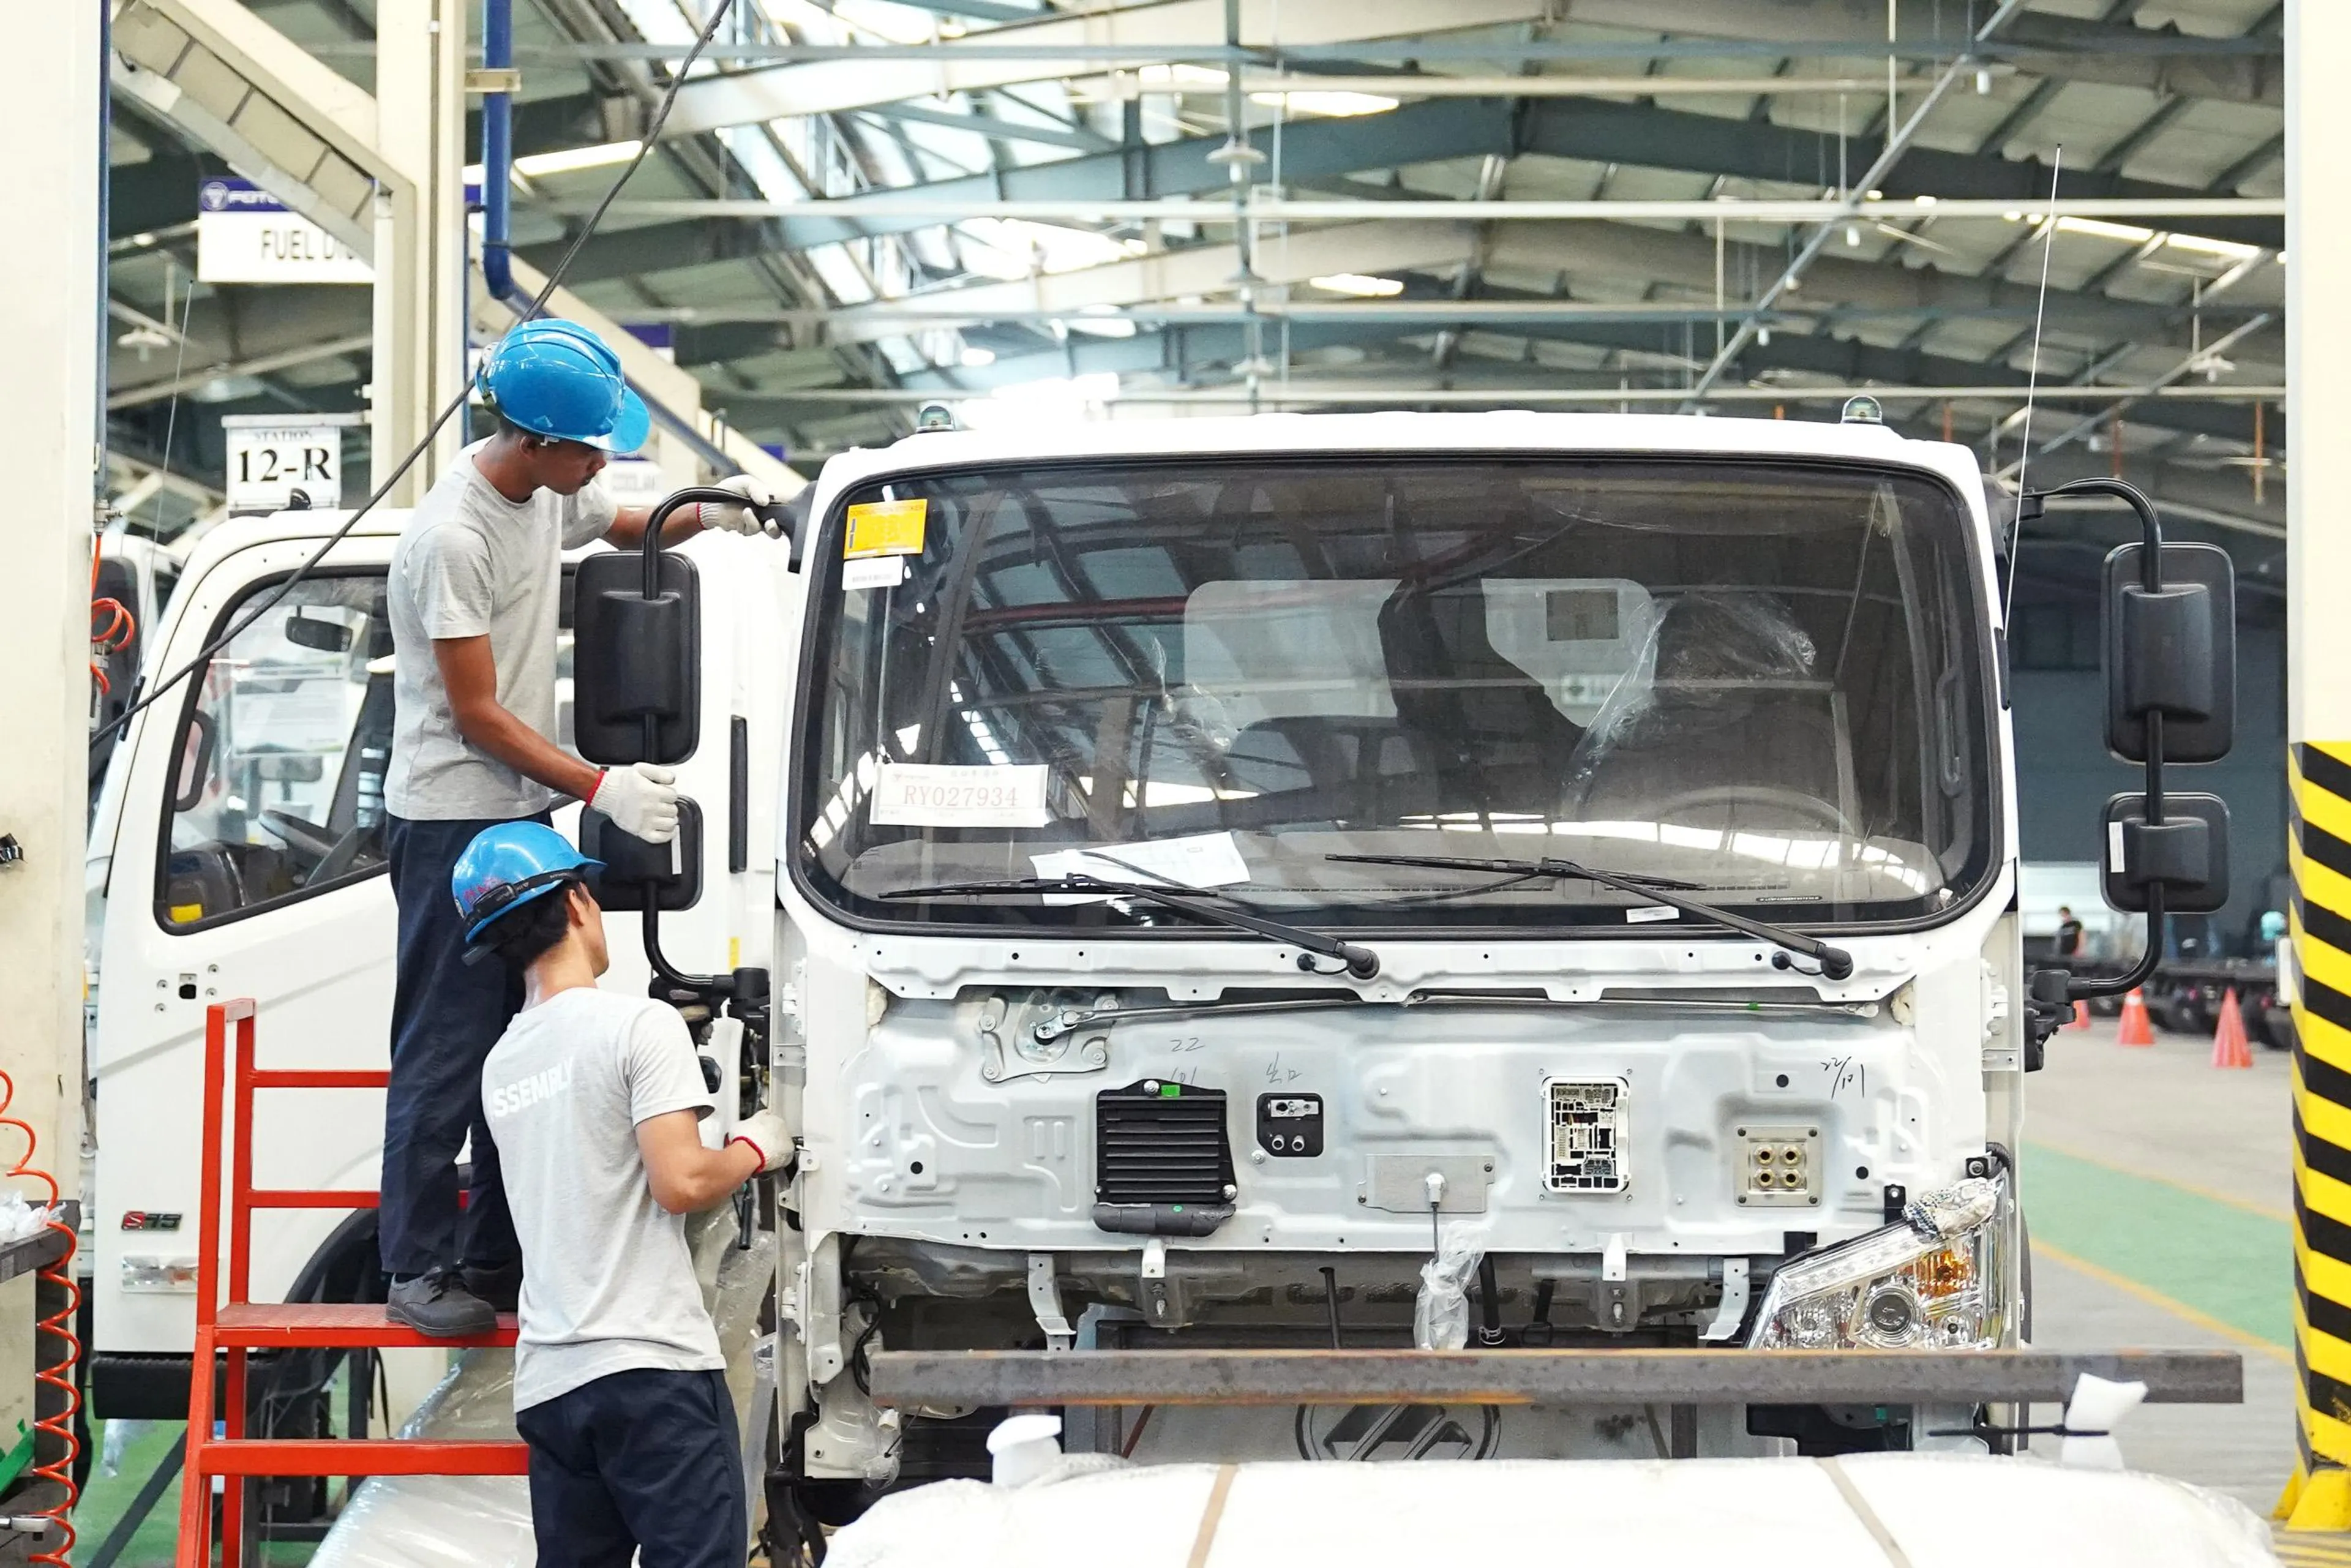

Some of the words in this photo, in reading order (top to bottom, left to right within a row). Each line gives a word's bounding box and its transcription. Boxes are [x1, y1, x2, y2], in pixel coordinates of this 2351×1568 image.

[261, 229, 315, 260] FUEL
[254, 430, 313, 441] STATION
[239, 448, 332, 482] 12-R
[903, 784, 1019, 807] RY027934
[489, 1056, 574, 1122] SSEMBLY
